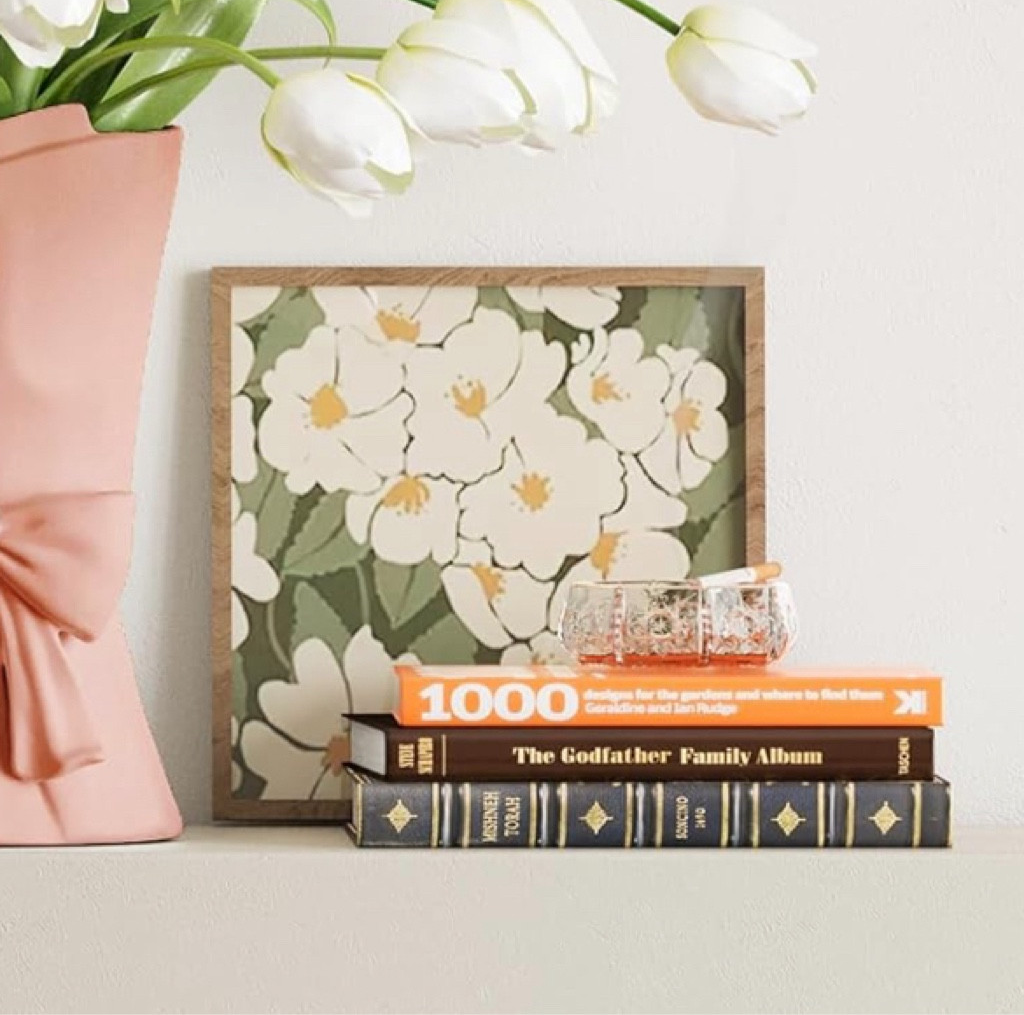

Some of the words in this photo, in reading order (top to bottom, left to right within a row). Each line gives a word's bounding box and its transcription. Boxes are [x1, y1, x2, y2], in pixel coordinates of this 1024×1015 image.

[419, 683, 579, 722] 1000
[585, 703, 645, 715] Geraldine
[647, 703, 672, 715] and
[696, 703, 738, 717] Rudge
[635, 689, 655, 701] for
[657, 689, 679, 701] the
[735, 689, 760, 701] and
[762, 689, 804, 701] where
[805, 690, 819, 701] to
[821, 689, 847, 701] find
[849, 689, 885, 701] them
[513, 746, 555, 765] The
[561, 746, 672, 765] Godfather
[679, 746, 751, 767] Family
[756, 746, 824, 765] Album
[482, 791, 499, 843] MISHNEH
[504, 797, 521, 837] TORAH
